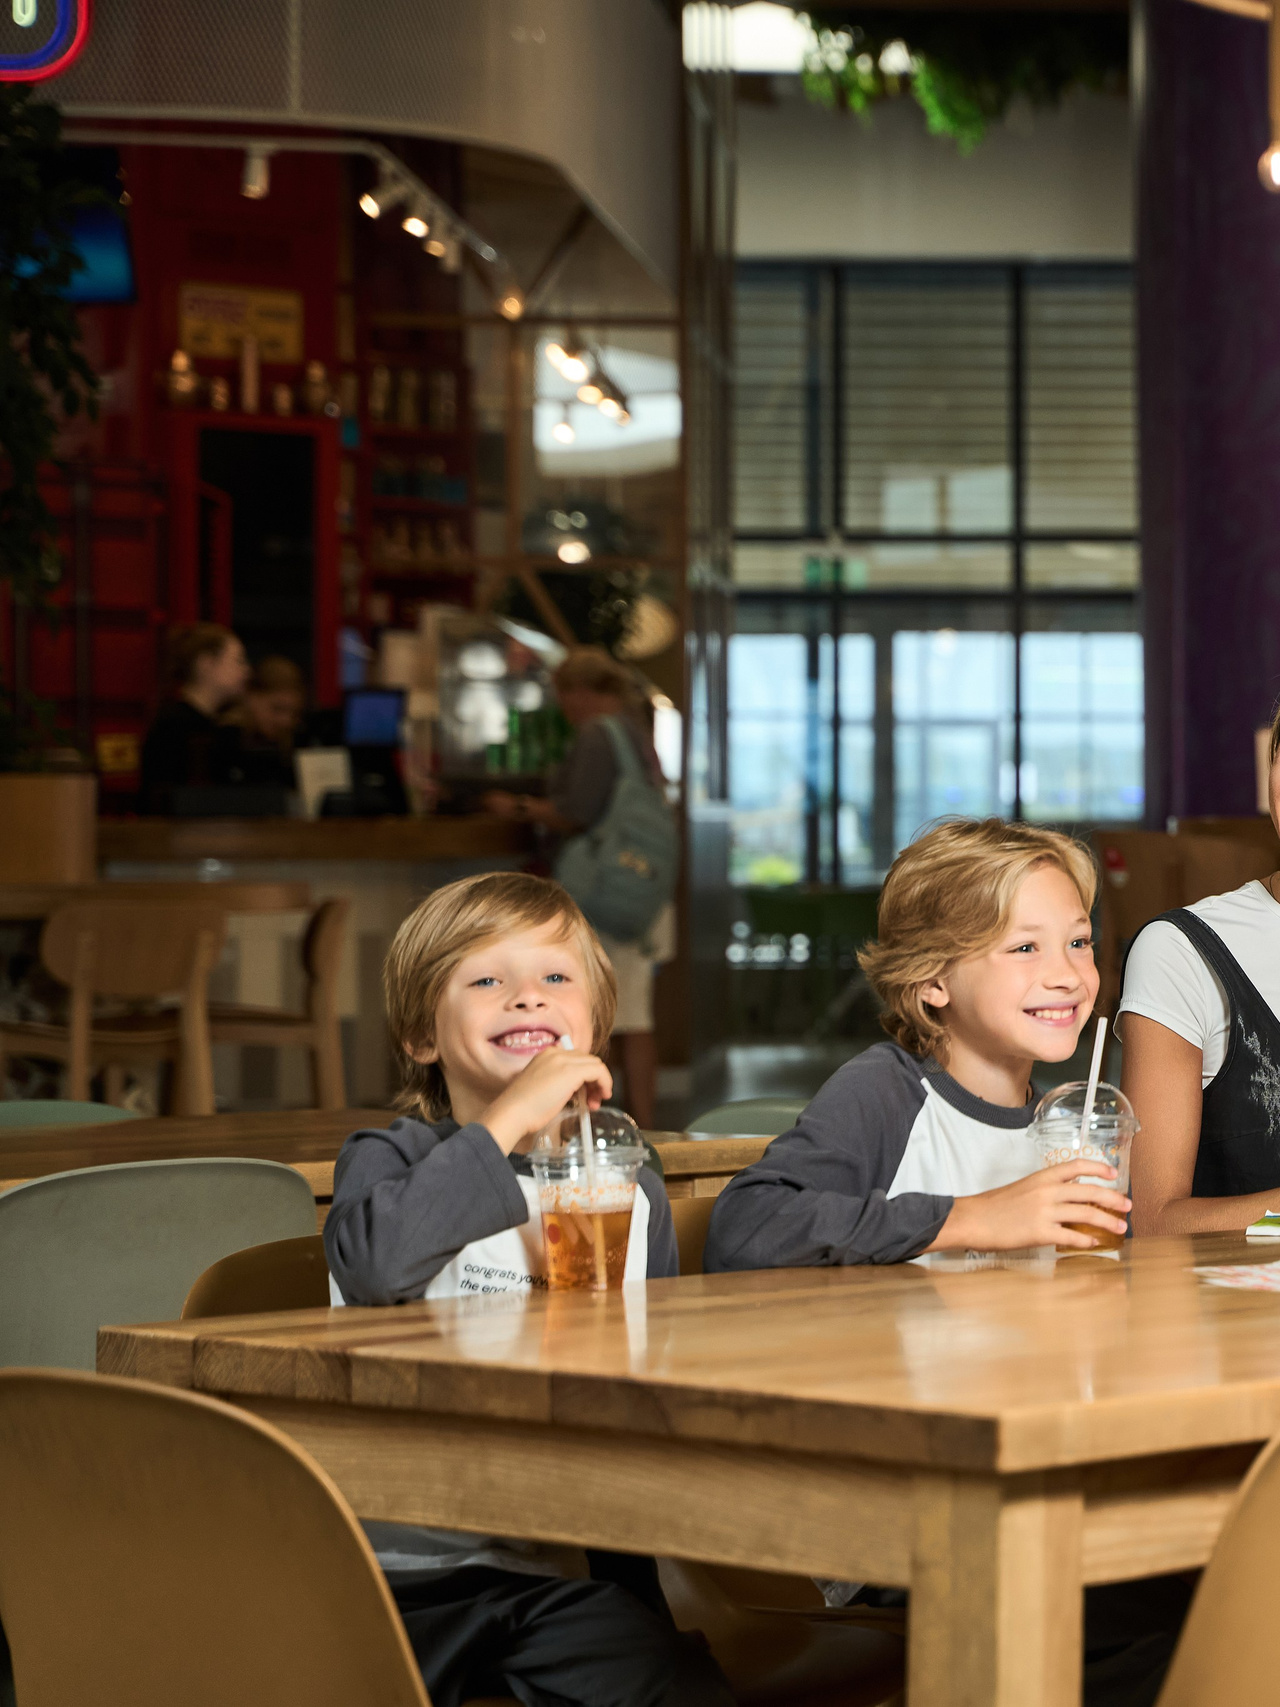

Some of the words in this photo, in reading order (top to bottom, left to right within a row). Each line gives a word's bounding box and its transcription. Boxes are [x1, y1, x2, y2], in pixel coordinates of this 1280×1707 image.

[459, 1277, 480, 1291] the
[464, 1263, 517, 1281] congrats
[516, 1273, 550, 1290] you'v
